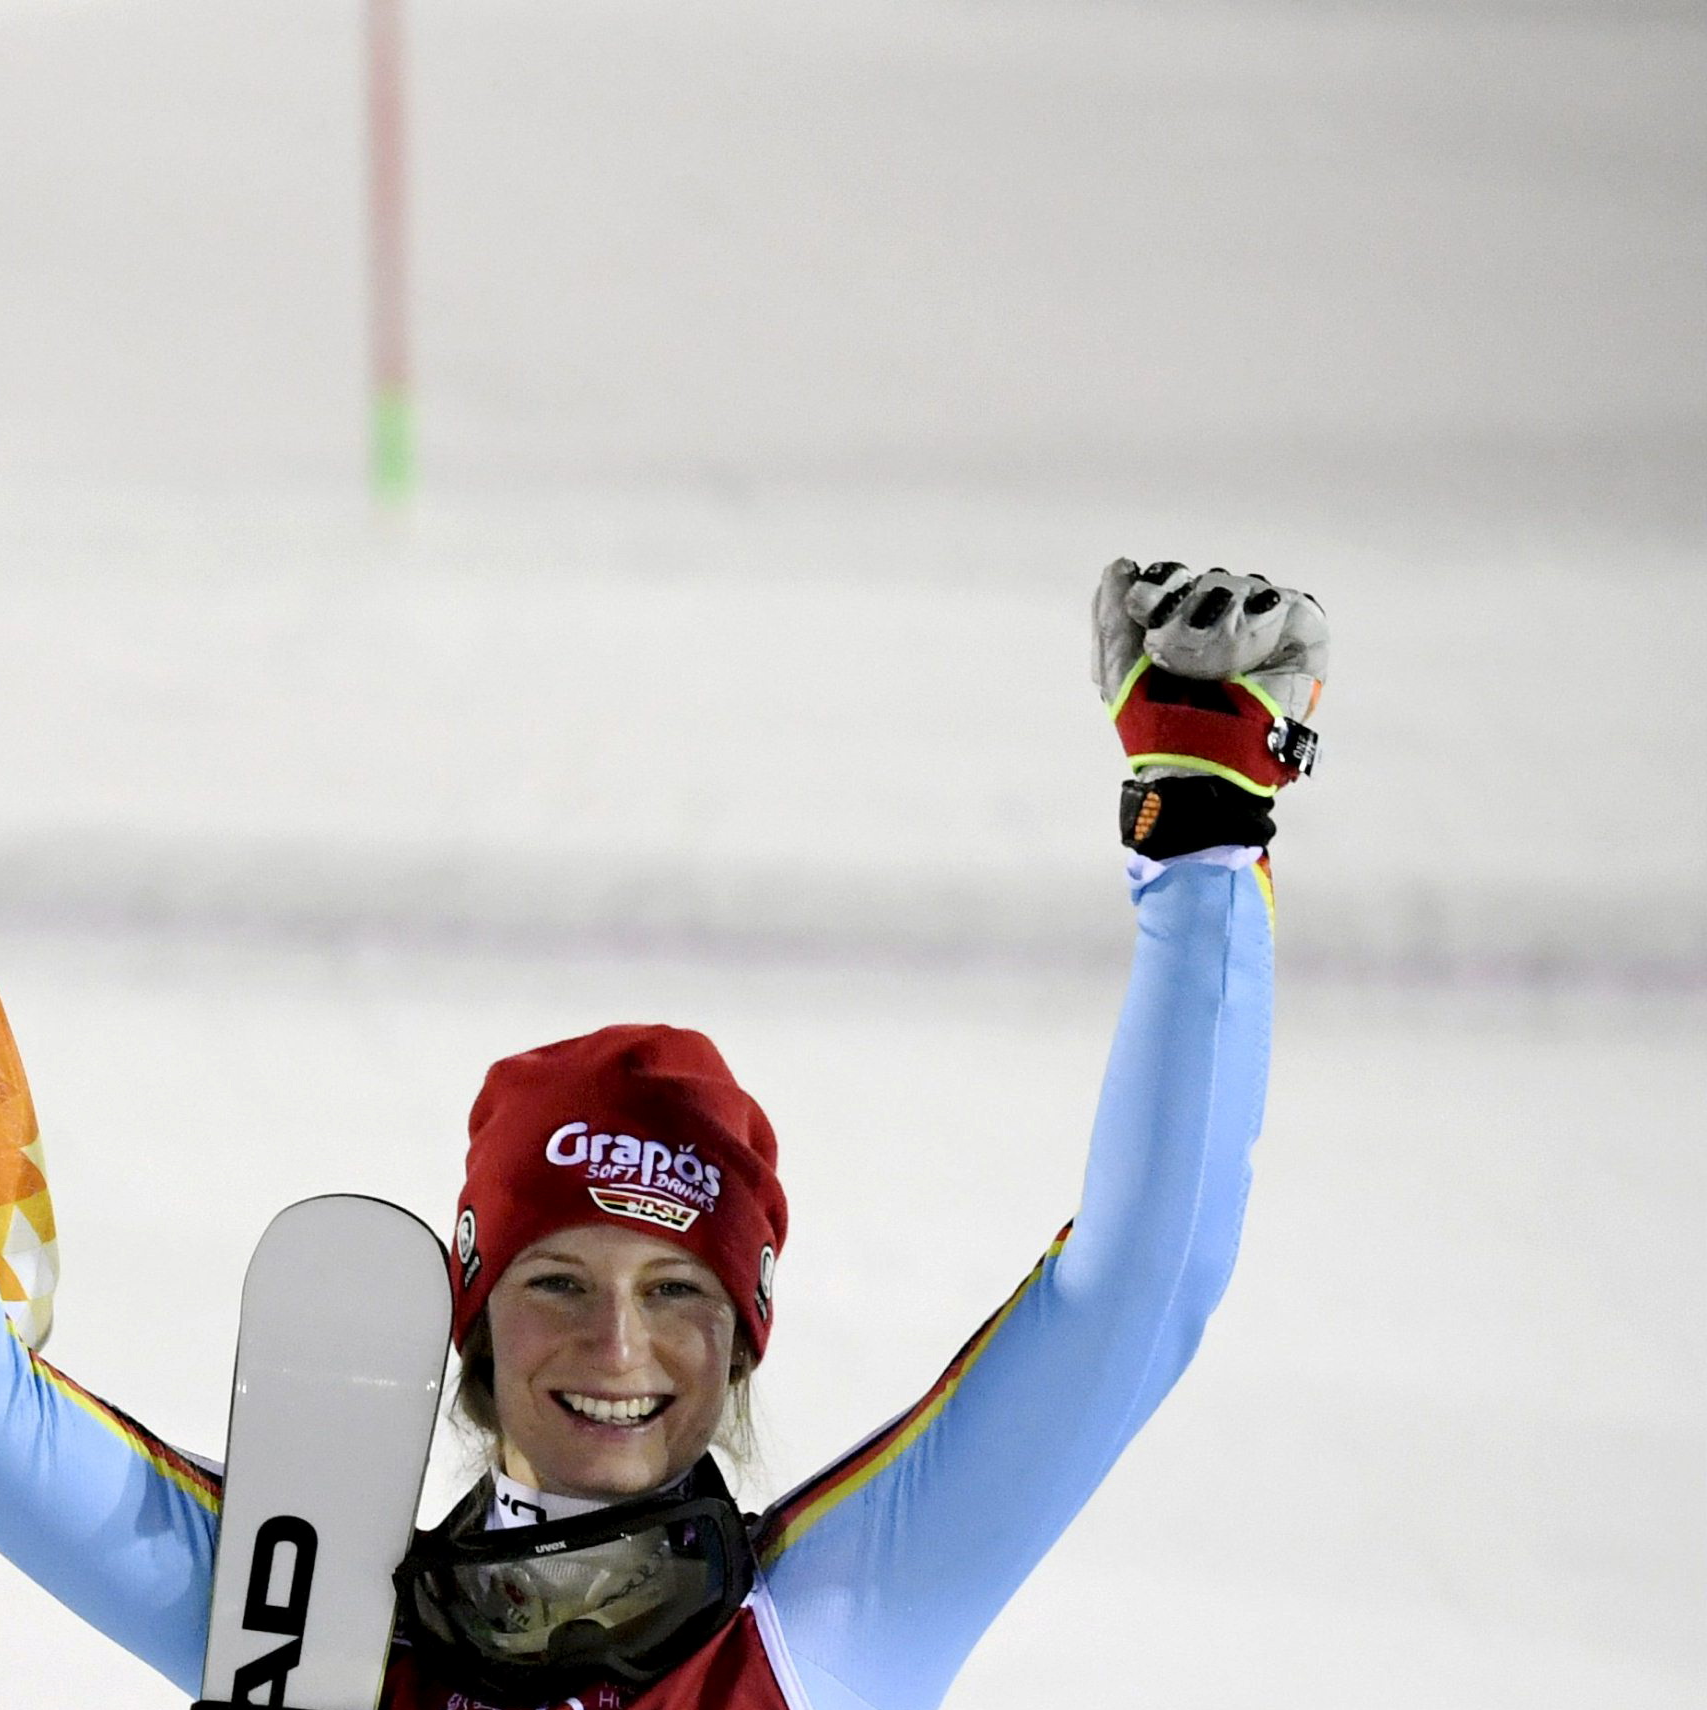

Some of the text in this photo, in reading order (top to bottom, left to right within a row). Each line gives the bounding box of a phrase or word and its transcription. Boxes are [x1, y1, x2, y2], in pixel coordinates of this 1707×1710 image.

[585, 1164, 716, 1213] SOFT DRINKS
[535, 1540, 567, 1554] uvex
